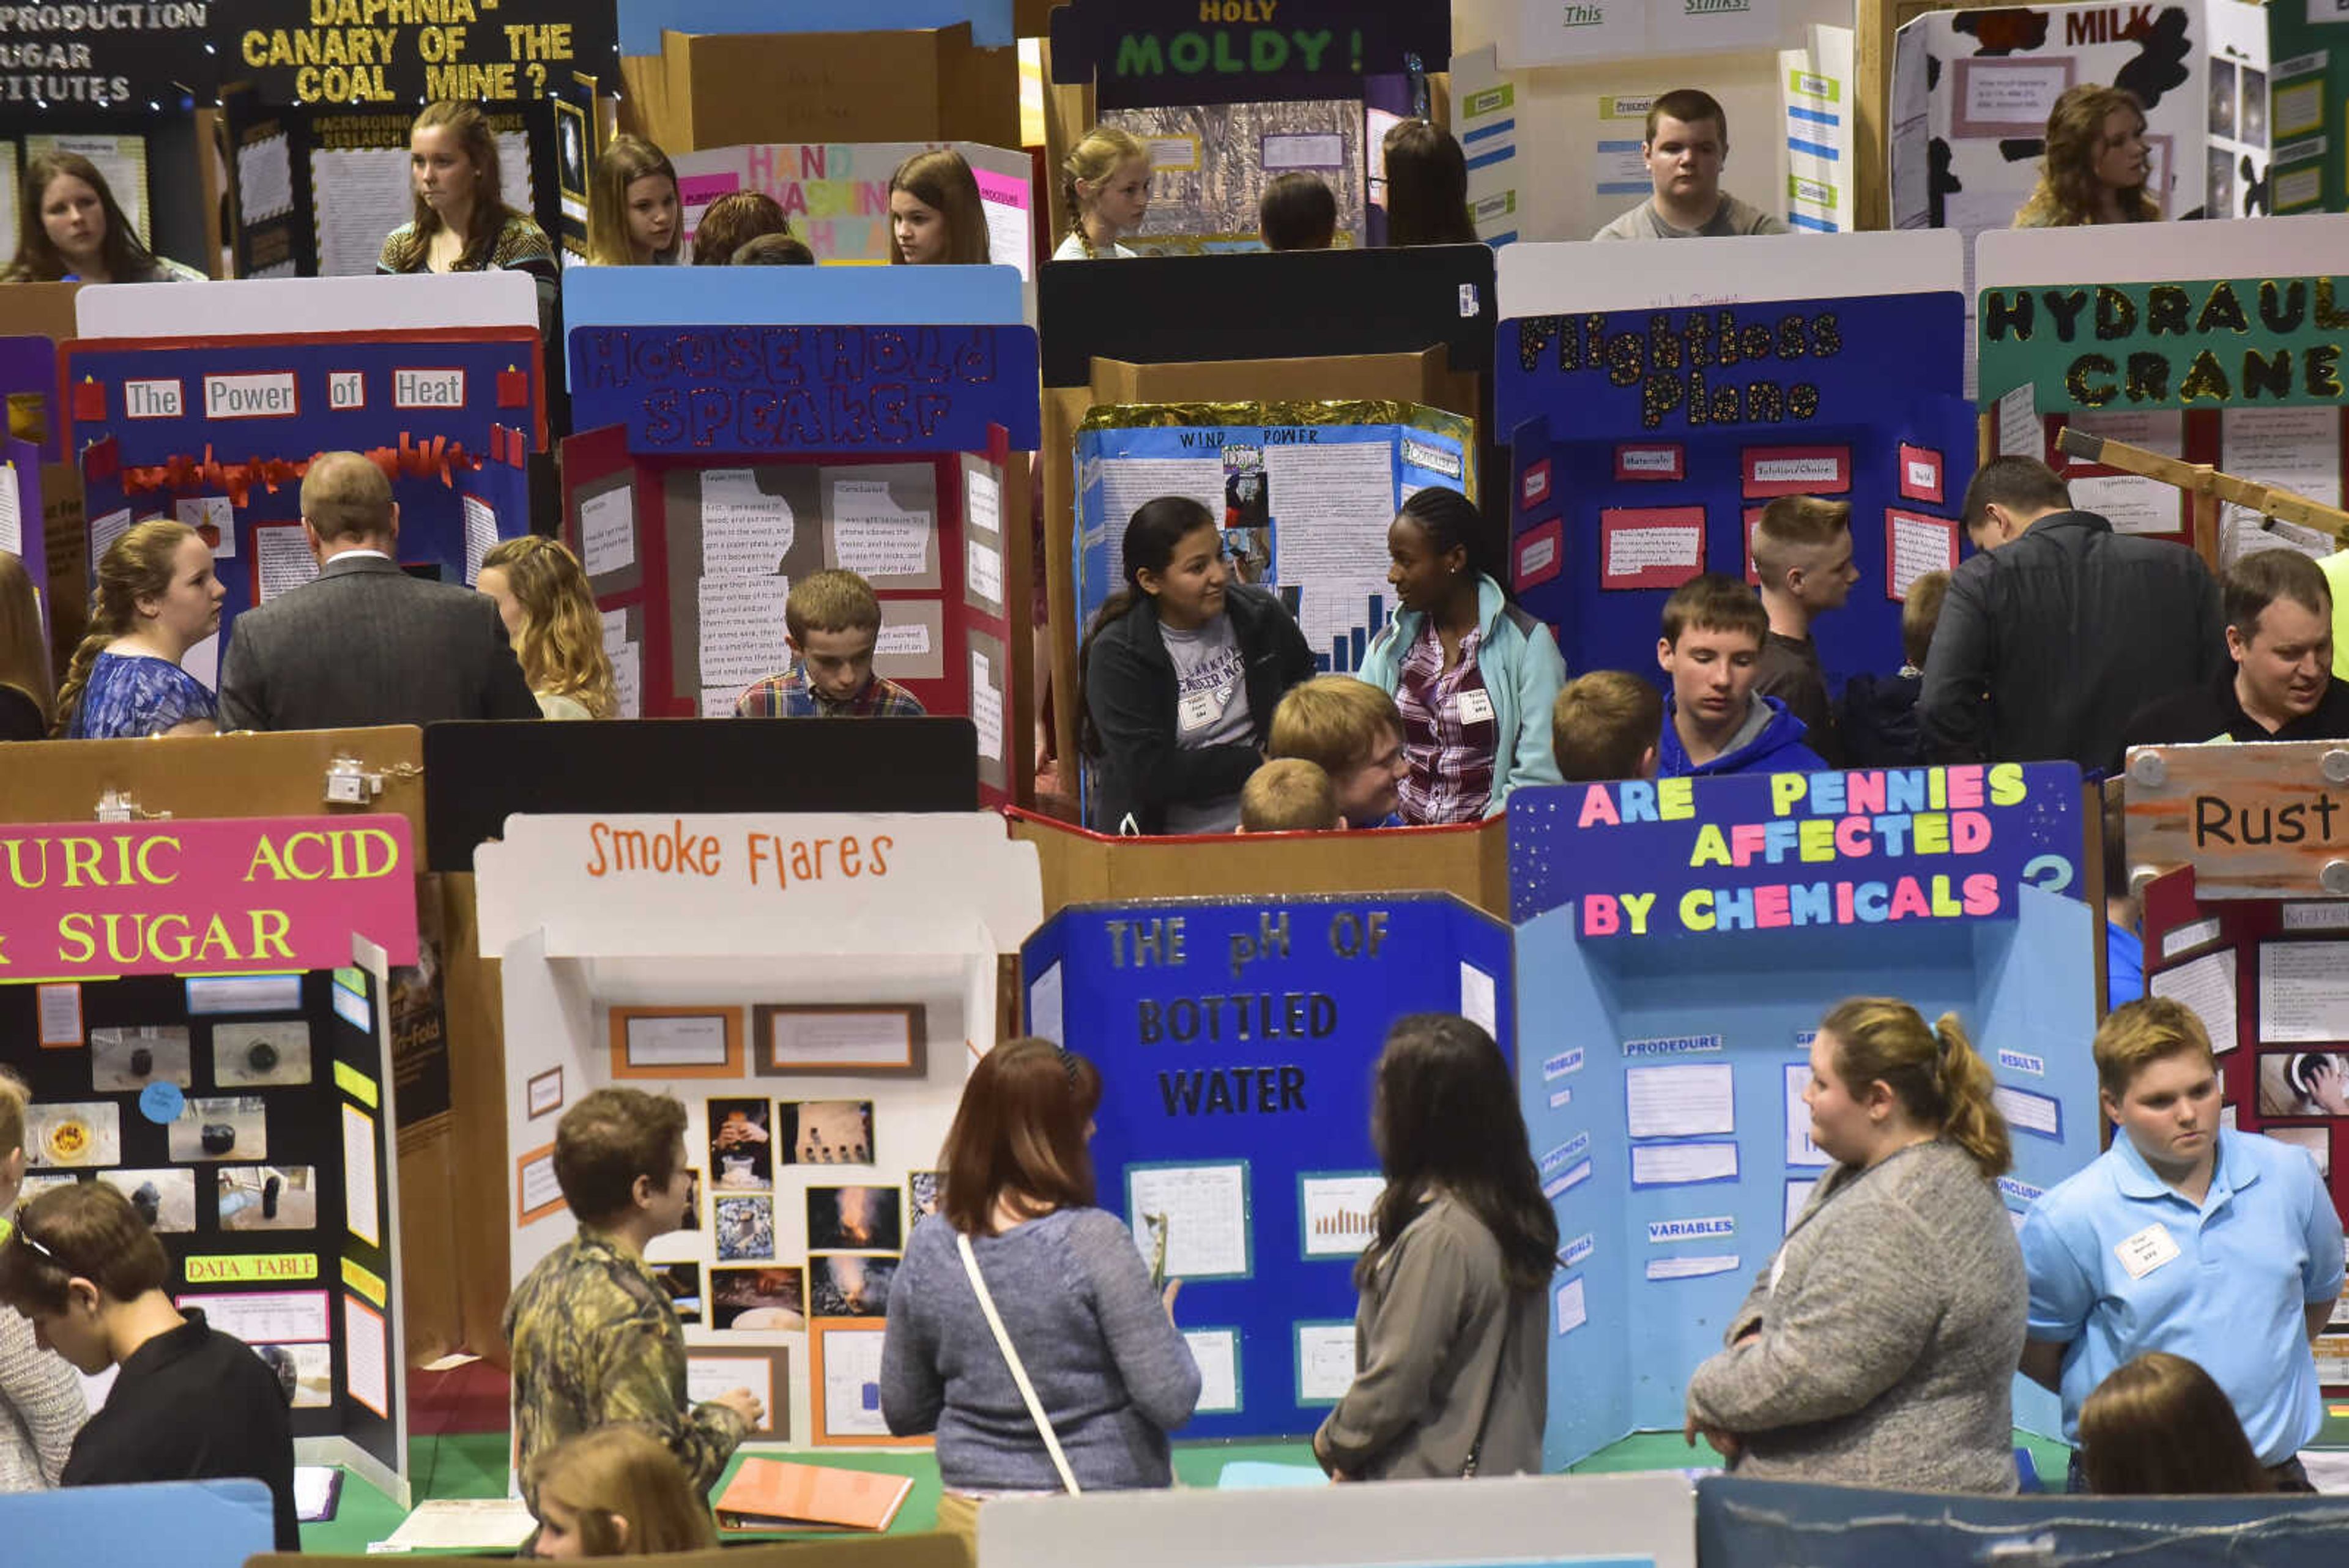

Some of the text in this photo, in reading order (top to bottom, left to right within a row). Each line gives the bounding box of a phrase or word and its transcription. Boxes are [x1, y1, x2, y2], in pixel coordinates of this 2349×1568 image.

[0, 2, 207, 31] PRODUCTION
[1200, 0, 1277, 22] HOLY
[1564, 7, 1601, 23] This
[2066, 3, 2154, 46] MILK
[242, 23, 573, 67] CANARY OF THE
[0, 76, 130, 102] ITUTES
[295, 65, 395, 102] COAL
[749, 144, 853, 180] HAND
[755, 180, 889, 217] WASHIN
[1518, 310, 1842, 387] Flightless
[129, 374, 460, 414] The Power of Heat
[2065, 344, 2343, 406] CRANE
[1642, 370, 1820, 429] Plane
[1181, 429, 1317, 448] WIND POWER
[1578, 763, 2027, 827] ARE PENNIES
[1690, 812, 1992, 867] AFFECTED
[2196, 794, 2340, 847] Rust
[0, 829, 398, 888] URIC ACID
[587, 819, 893, 889] Smoke Flares
[1583, 892, 1656, 935] BY
[58, 909, 297, 964] SUGAR
[1105, 912, 1389, 978] THE pH OF
[1138, 992, 1337, 1046] BOTTLED
[1626, 1035, 1719, 1055] PRODEDURE
[2001, 1053, 2041, 1071] RESULTS
[1158, 1066, 1307, 1117] WATER
[1650, 1220, 1732, 1236] VARIABLES
[189, 1256, 313, 1279] DATA TABLE
